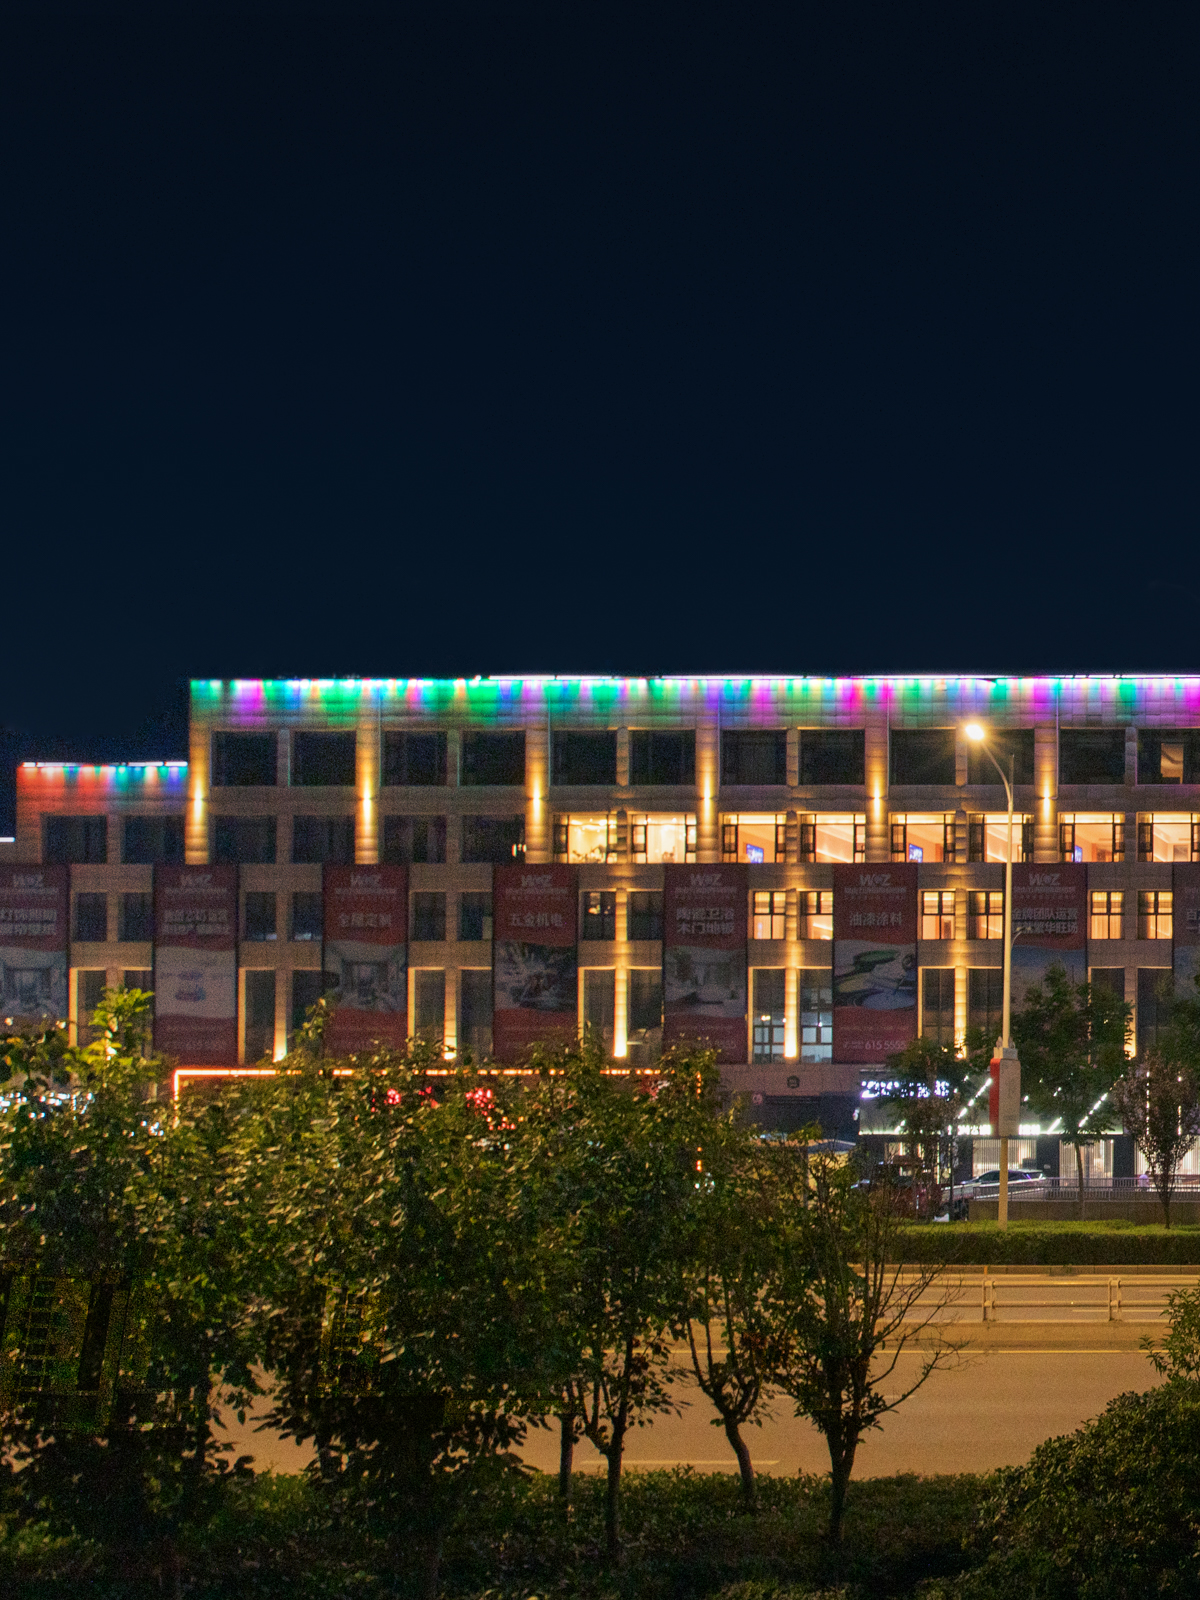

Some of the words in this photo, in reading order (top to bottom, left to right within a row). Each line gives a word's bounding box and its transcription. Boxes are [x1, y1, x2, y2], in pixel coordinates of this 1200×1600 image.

[510, 912, 563, 928] 五金机电
[849, 911, 902, 927] 油漆涂料
